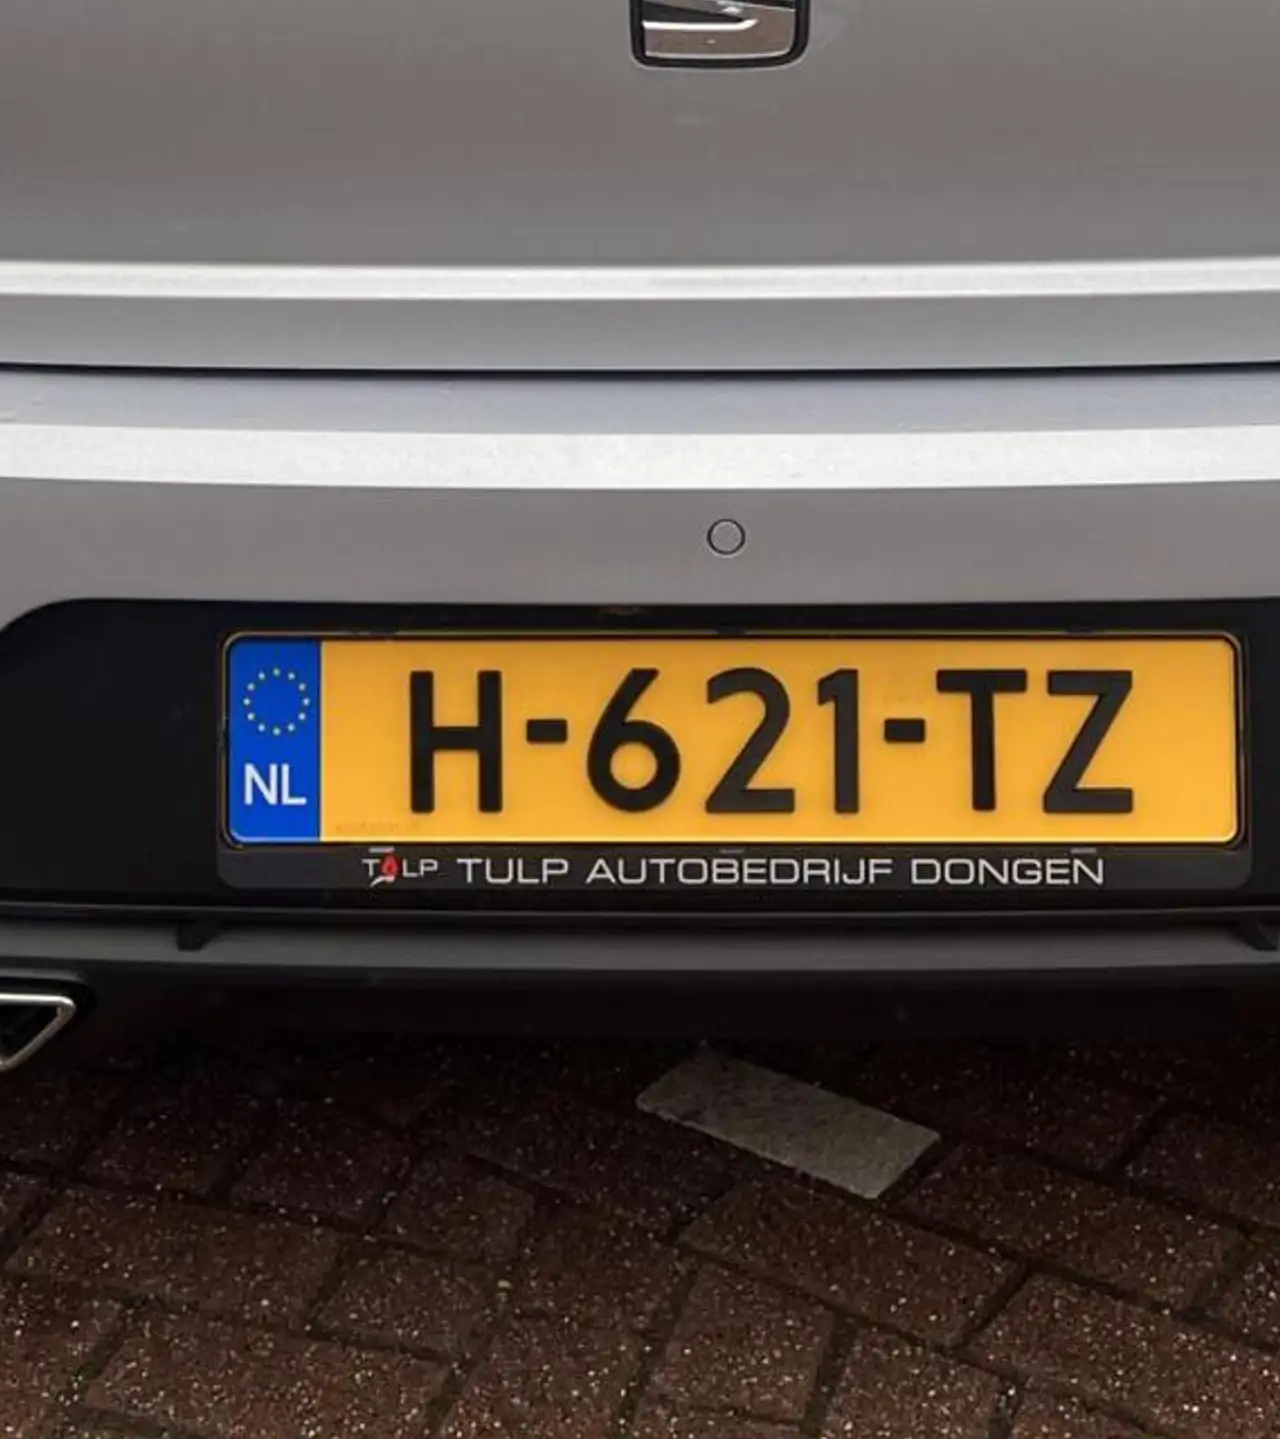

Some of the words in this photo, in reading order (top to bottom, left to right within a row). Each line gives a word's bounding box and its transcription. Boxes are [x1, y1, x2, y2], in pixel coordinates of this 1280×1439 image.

[408, 667, 1135, 814] H-621-TZ
[244, 763, 307, 806] NL
[456, 857, 569, 884] TULP
[585, 857, 894, 885] AUTOBEDRIJF
[910, 857, 1105, 885] DONGEN
